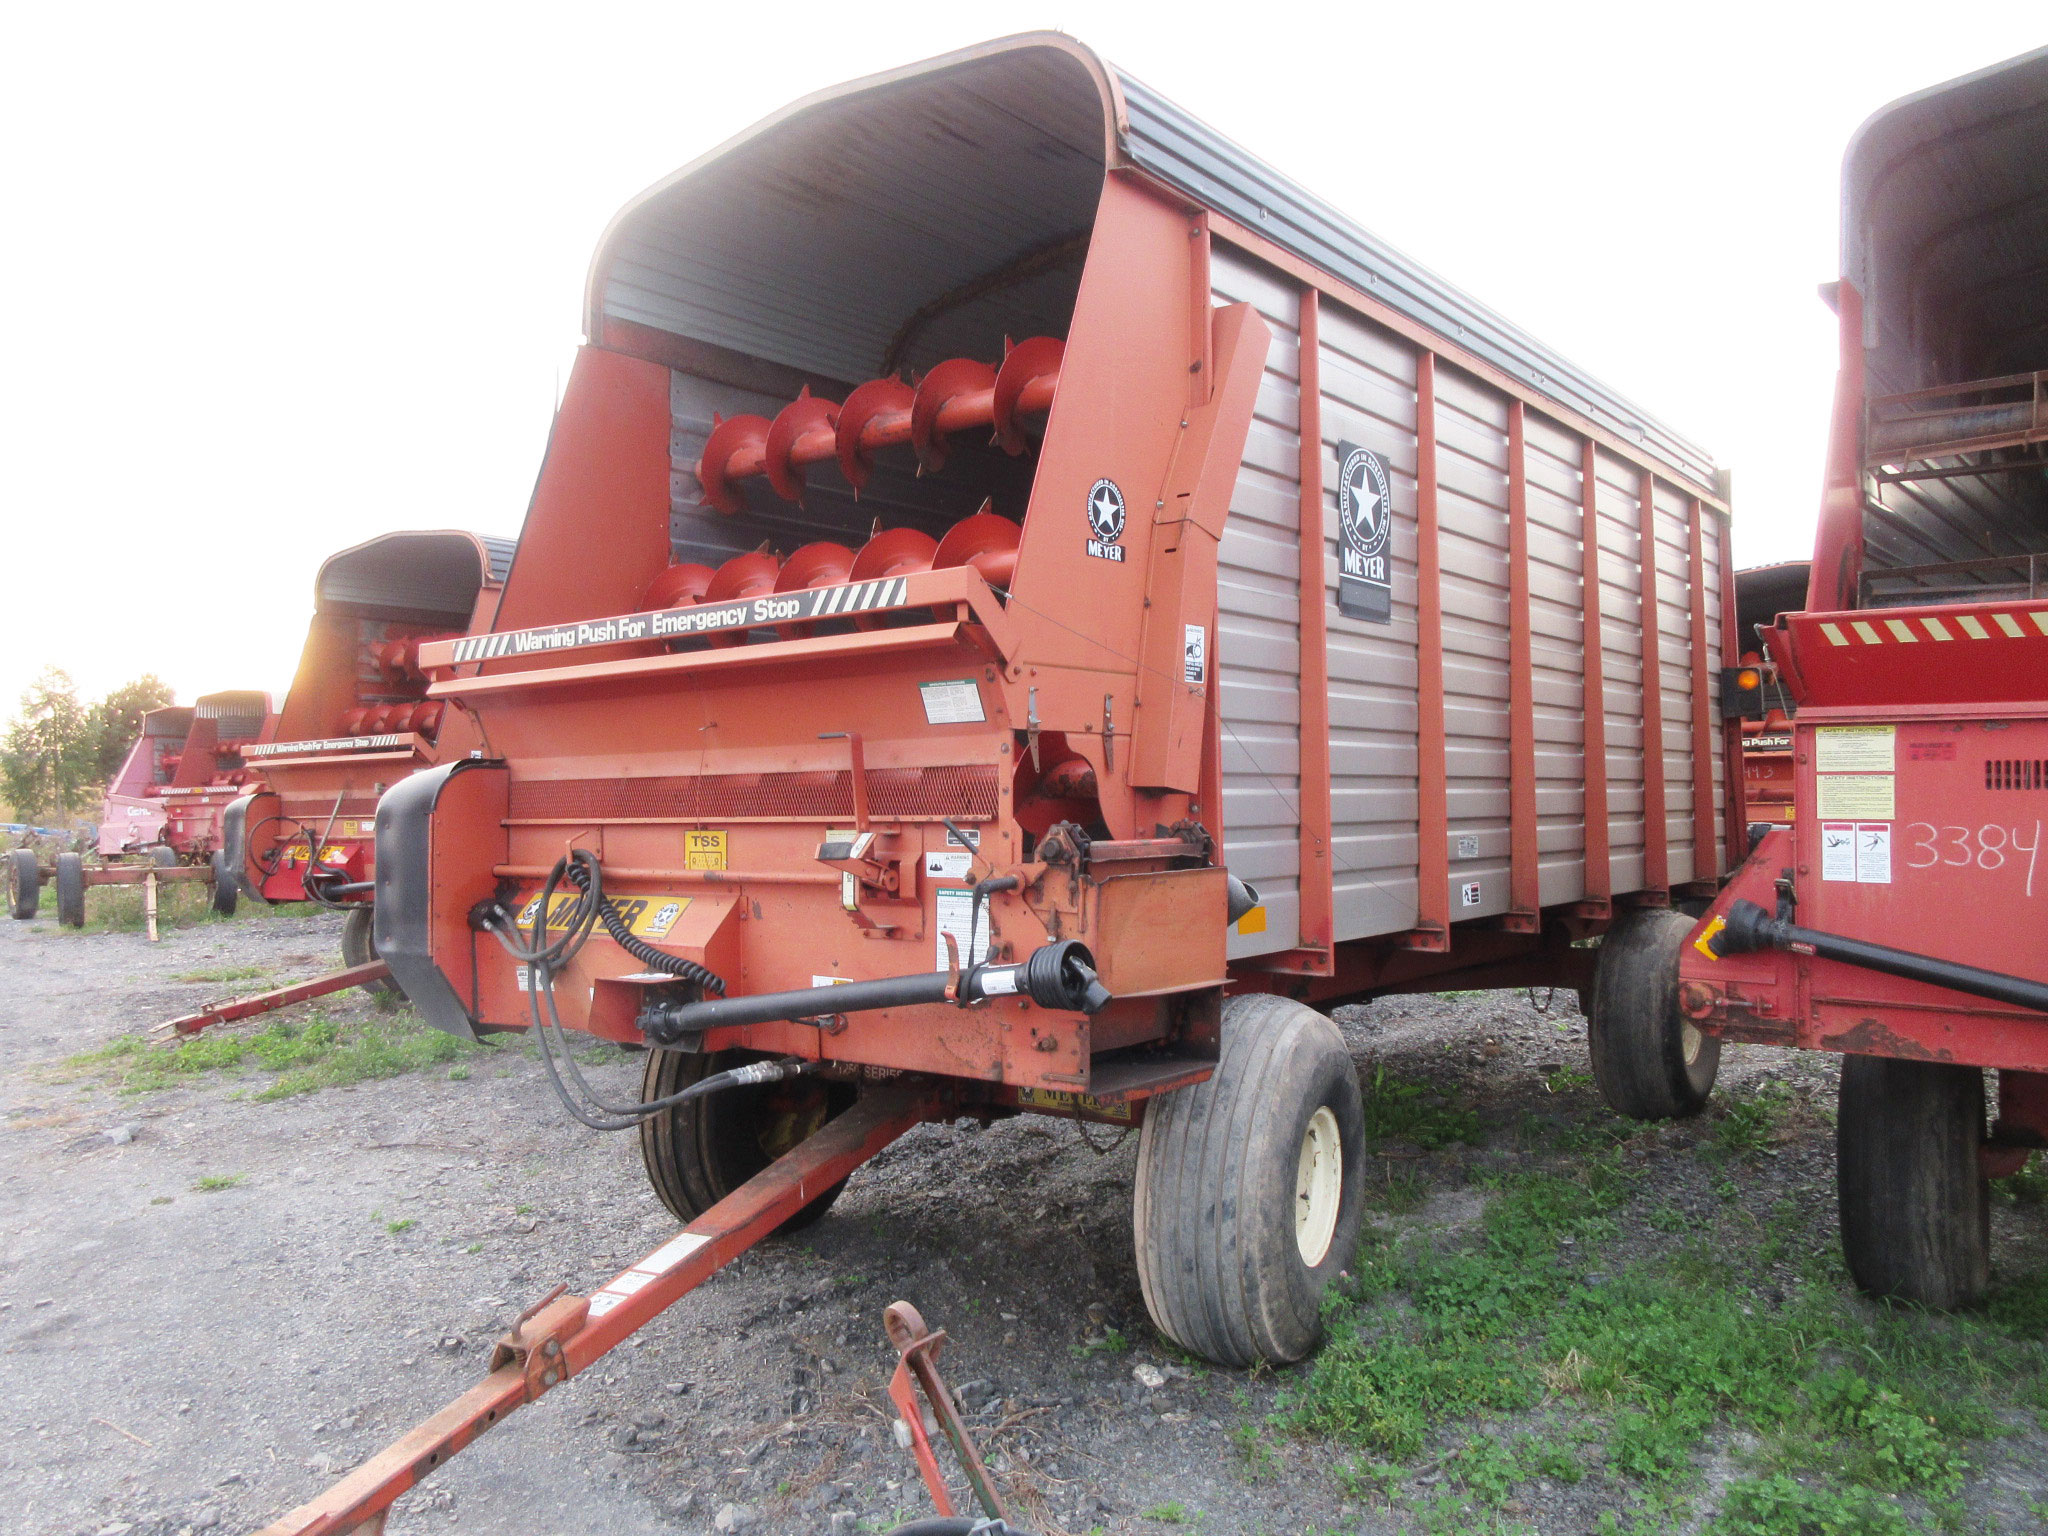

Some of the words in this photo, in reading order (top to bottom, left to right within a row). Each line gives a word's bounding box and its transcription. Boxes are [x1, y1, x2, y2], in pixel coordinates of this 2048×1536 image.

[1088, 539, 1122, 562] MEYER
[1344, 547, 1385, 580] MEYER
[515, 629, 575, 652] Warning
[578, 621, 616, 644] Push
[619, 618, 646, 639] For
[652, 606, 748, 634] Emergency
[754, 599, 800, 622] Stop
[300, 742, 313, 752] Push
[313, 741, 322, 750] For
[323, 739, 353, 750] Emergency
[355, 738, 370, 747] Stop
[691, 835, 720, 847] TSS
[1905, 820, 2040, 897] 3384
